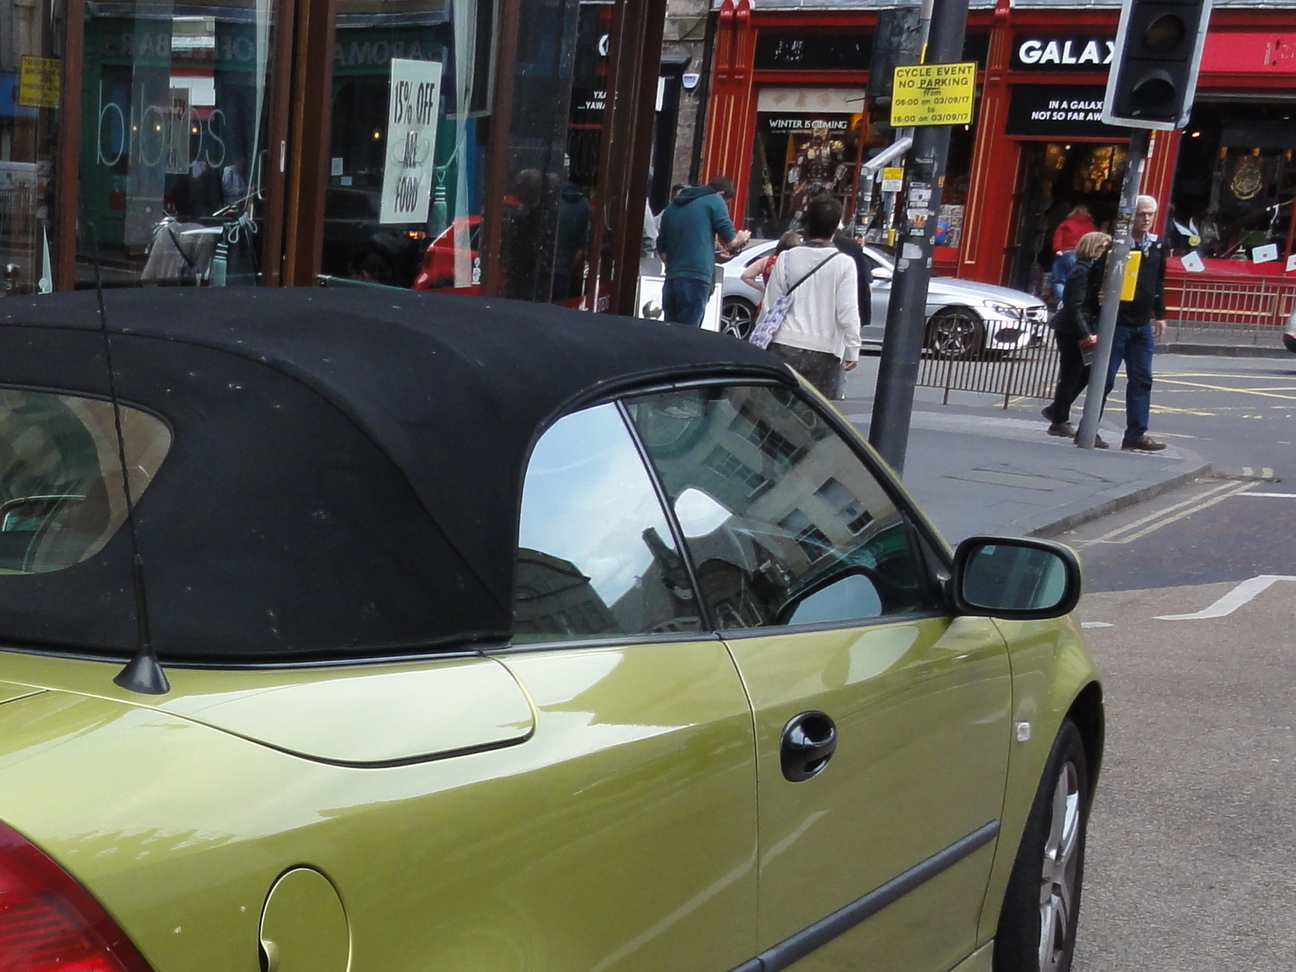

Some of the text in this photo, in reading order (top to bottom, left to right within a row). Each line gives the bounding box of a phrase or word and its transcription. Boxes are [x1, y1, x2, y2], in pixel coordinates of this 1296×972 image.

[896, 66, 973, 78] CYCLE EVENT
[898, 77, 969, 89] NO PARKING
[393, 81, 435, 125] 15% OFF
[933, 96, 970, 105] 03/09/17
[1048, 100, 1059, 109] IN
[1060, 101, 1068, 109] A
[931, 113, 968, 122] 03/09/17
[1031, 111, 1051, 120] NOT
[1052, 111, 1065, 120] SO
[1067, 112, 1085, 120] FAR
[769, 119, 847, 130] WINTER IS COMING
[394, 176, 418, 213] FOOD
